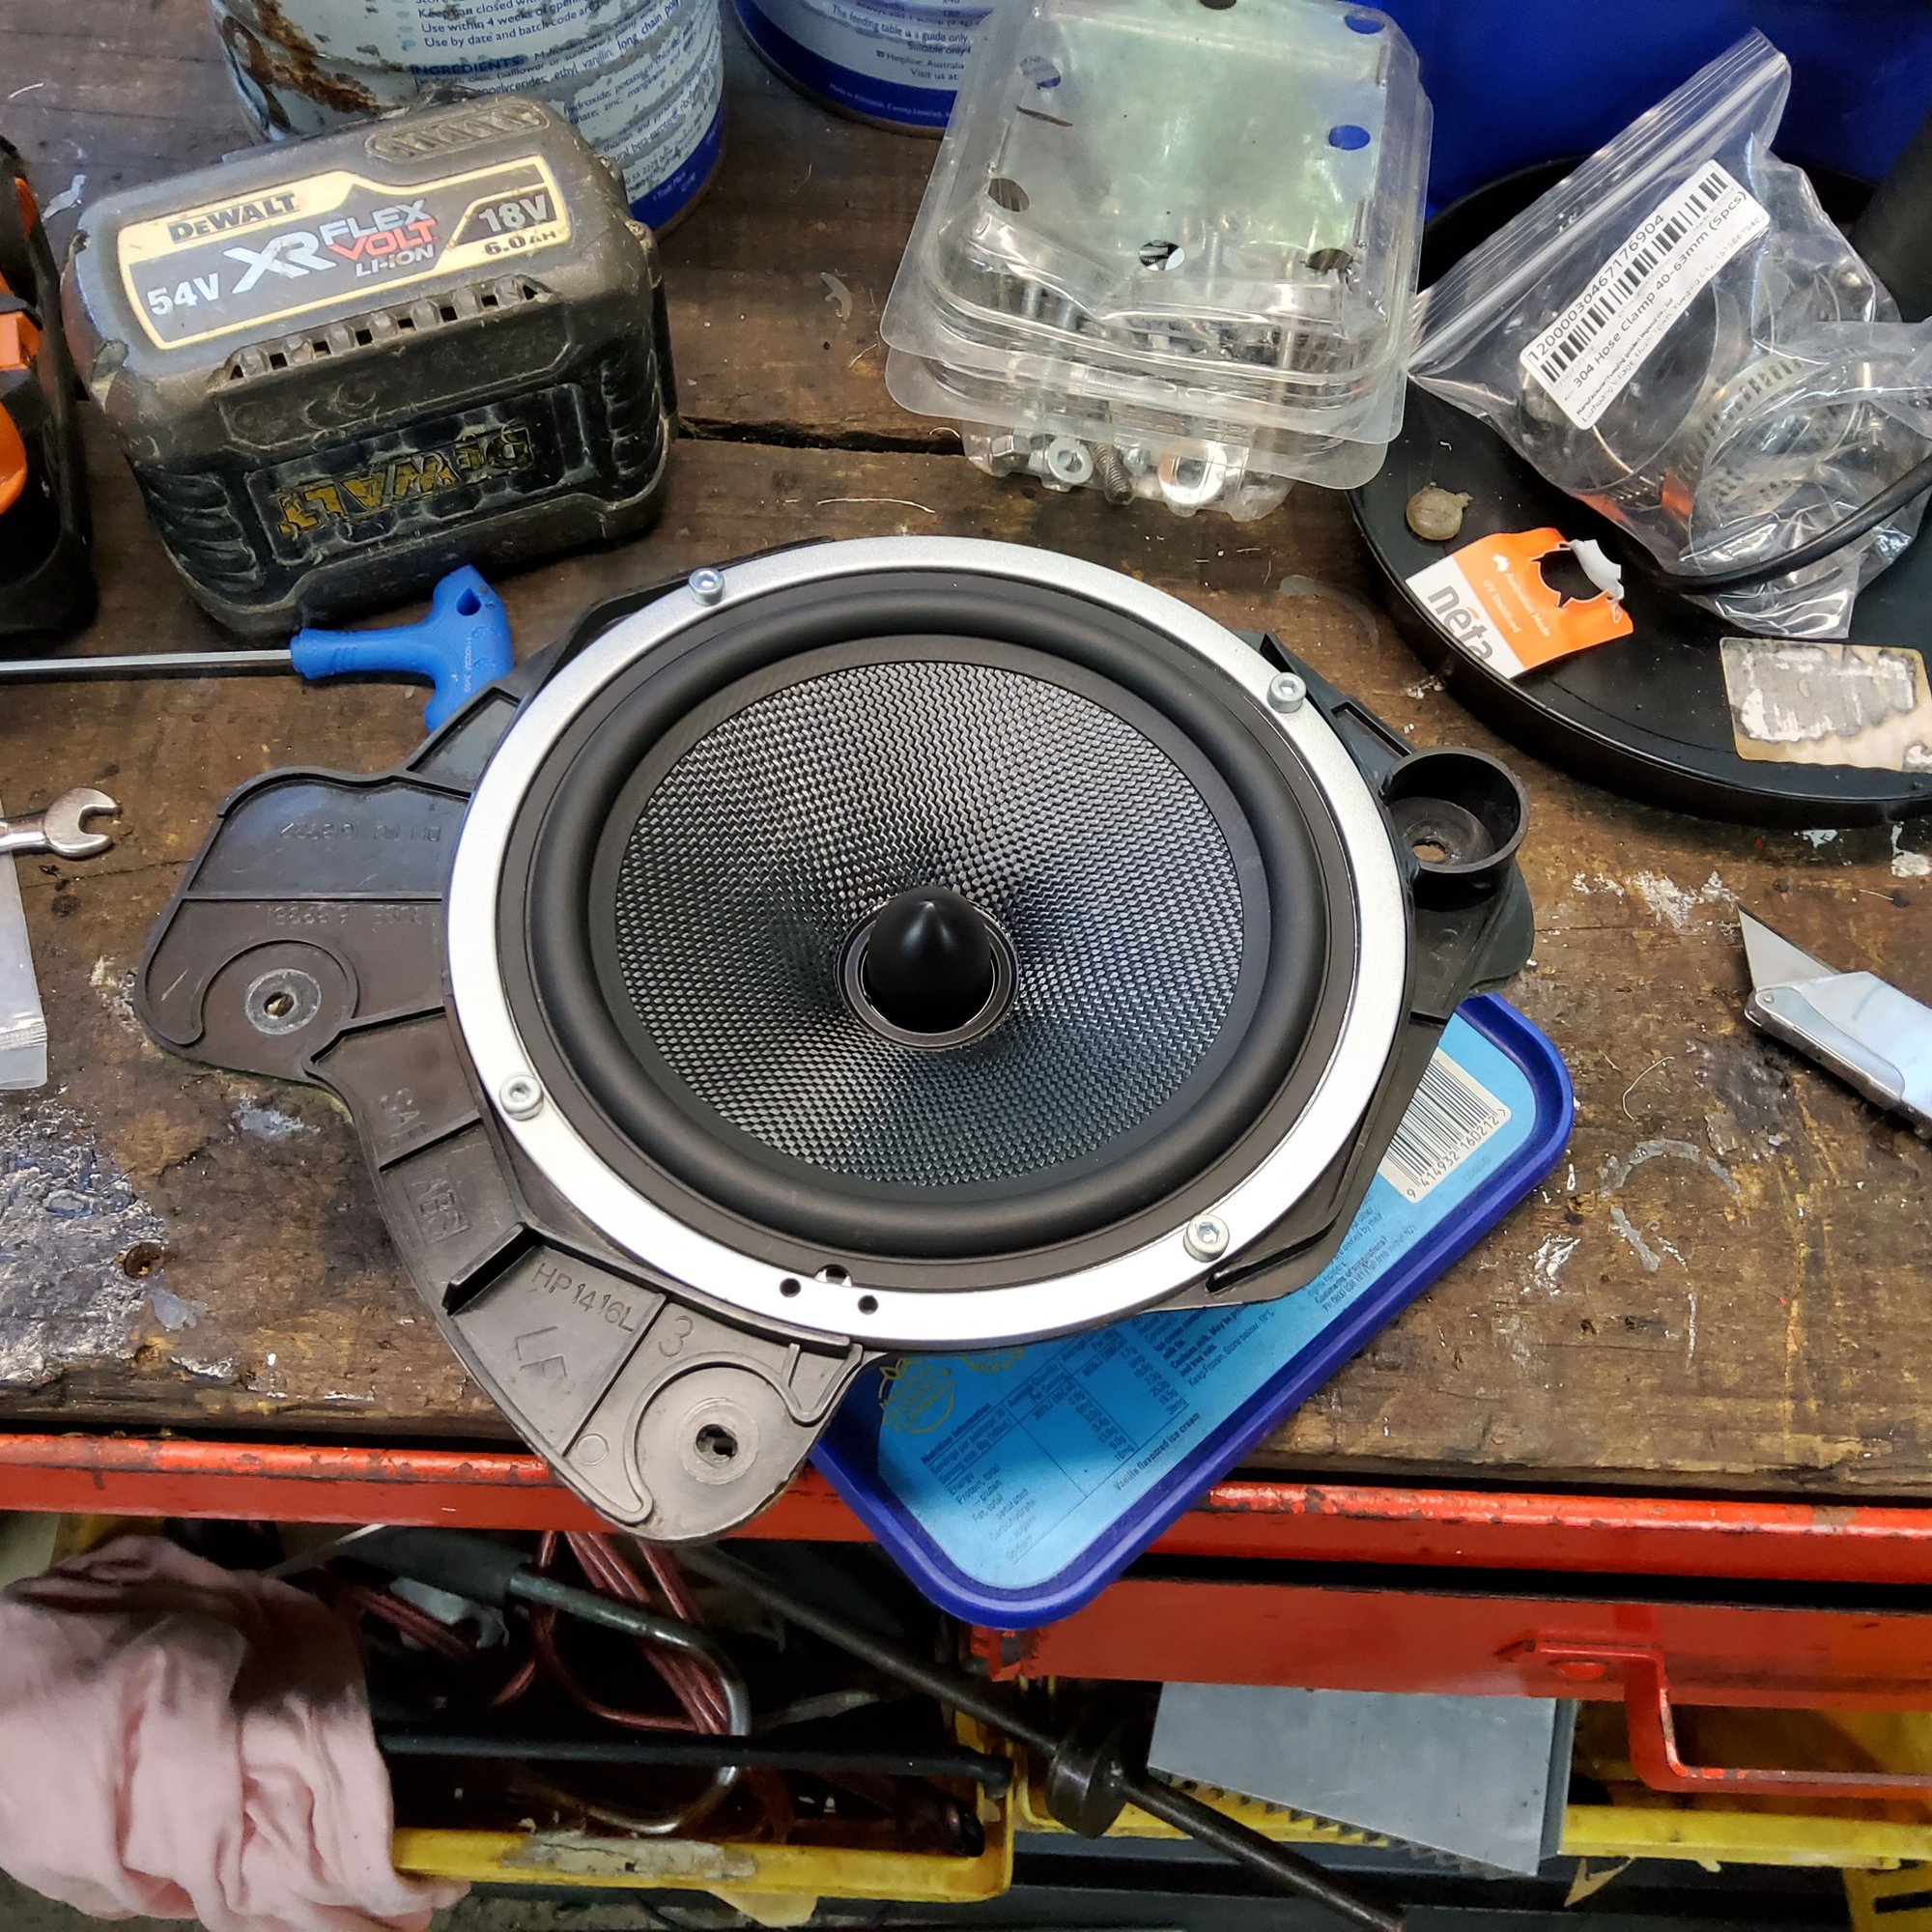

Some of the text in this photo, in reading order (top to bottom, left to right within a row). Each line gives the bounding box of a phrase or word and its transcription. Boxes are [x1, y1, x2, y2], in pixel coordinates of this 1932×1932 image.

[421, 23, 444, 34] Use
[447, 18, 484, 32] within
[487, 17, 495, 27] 4
[476, 0, 513, 14] closed
[849, 12, 879, 33] feeding
[424, 38, 448, 48] Use
[451, 36, 465, 48] by
[468, 34, 493, 45] date
[496, 27, 517, 41] and
[554, 63, 578, 80] ethyl
[617, 33, 639, 51] long
[641, 12, 662, 35] chain
[926, 59, 965, 70] Australia
[479, 194, 548, 233] 18V
[222, 198, 431, 294] XR FLEX
[328, 219, 438, 262] VOLT
[355, 243, 433, 277] LI-ION
[147, 272, 219, 316] 54V
[1571, 362, 1596, 387] 304
[1591, 330, 1624, 365] Hose
[1618, 290, 1659, 333] Clamp
[1653, 229, 1711, 292] 40-63mm
[1706, 188, 1748, 233] (5pcs)
[1482, 579, 1522, 635] UV Stabilised
[1503, 570, 1551, 639] Australian Made
[1406, 1186, 1418, 1200] 9
[1418, 1147, 1461, 1191] 414932
[1459, 1111, 1500, 1154] 160212
[658, 1316, 694, 1357] 3
